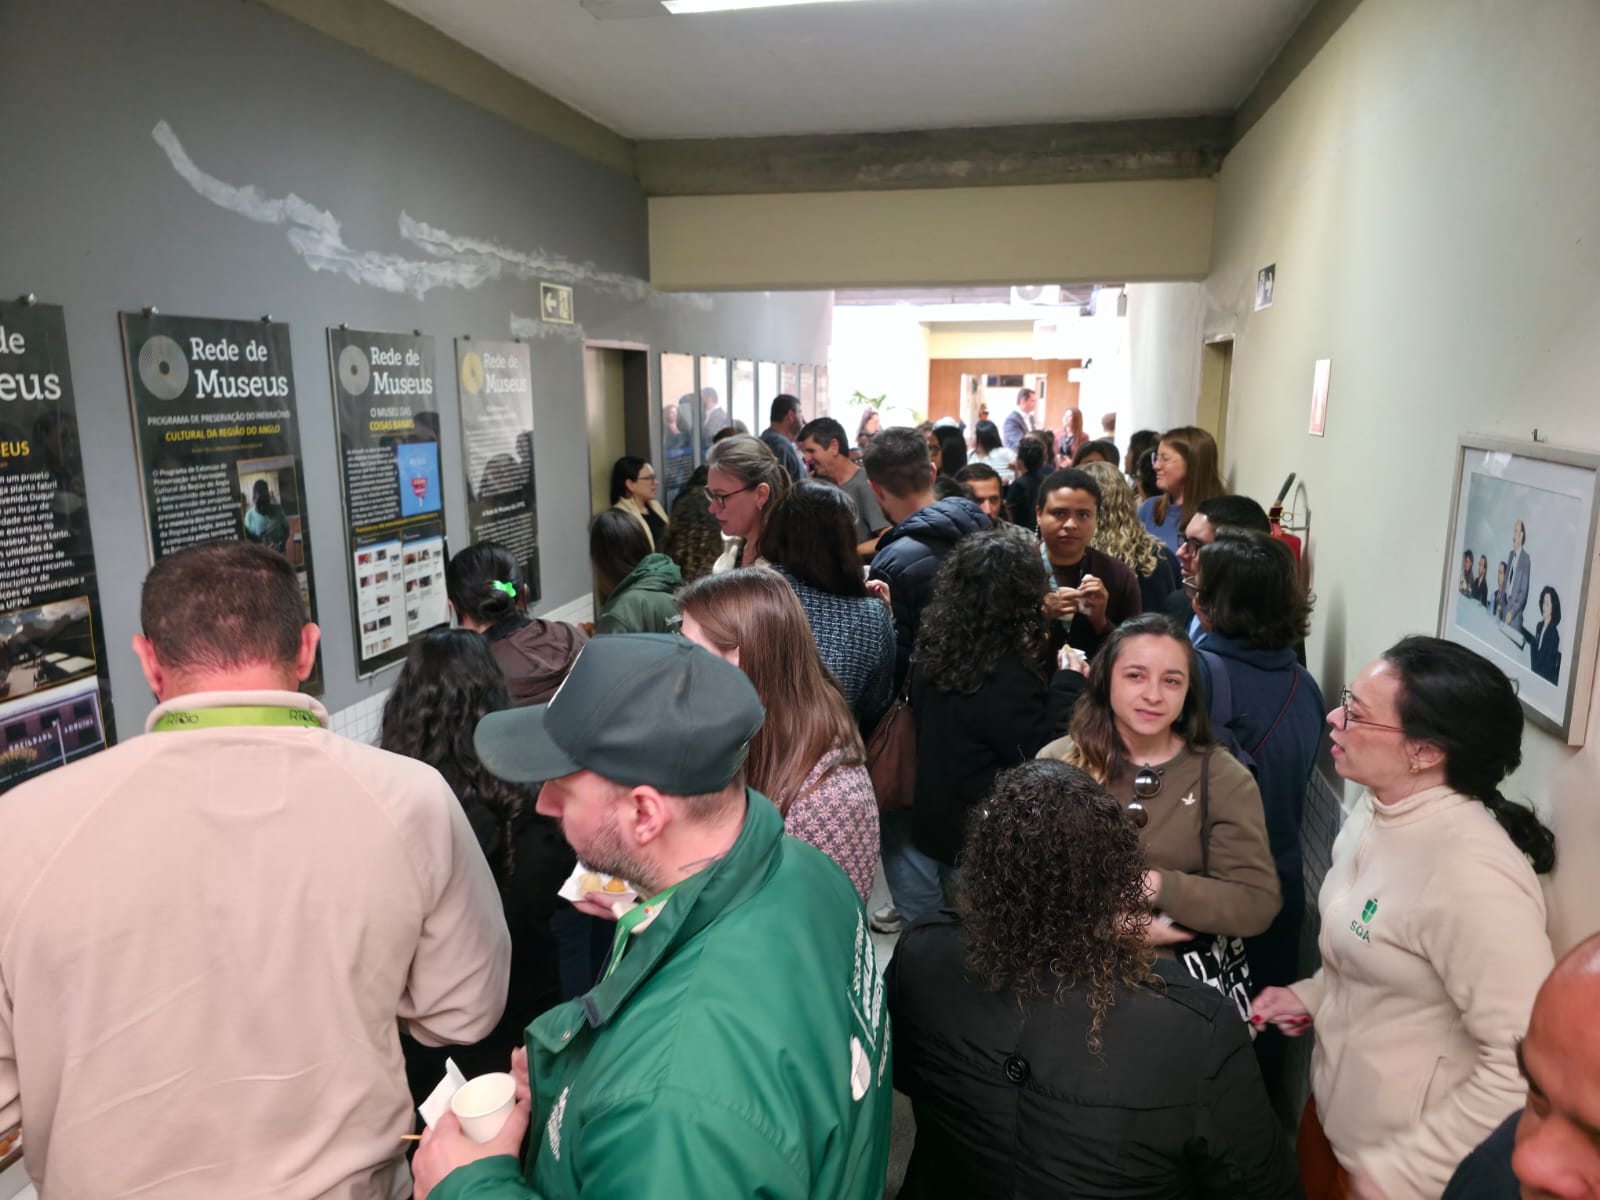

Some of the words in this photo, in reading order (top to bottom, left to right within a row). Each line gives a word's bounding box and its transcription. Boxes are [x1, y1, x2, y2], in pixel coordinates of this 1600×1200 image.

[190, 336, 239, 361] Rede
[246, 339, 268, 362] de
[370, 346, 402, 366] Rede
[405, 348, 420, 366] de
[194, 369, 288, 399] Museus
[373, 371, 433, 395] Museus
[485, 373, 528, 393] Museus
[147, 415, 189, 426] PROGRAMA
[191, 414, 199, 424] DE
[165, 429, 205, 441] CULTURAL
[207, 428, 217, 438] DA
[219, 425, 245, 437] REGIÃO
[246, 426, 257, 436] DO
